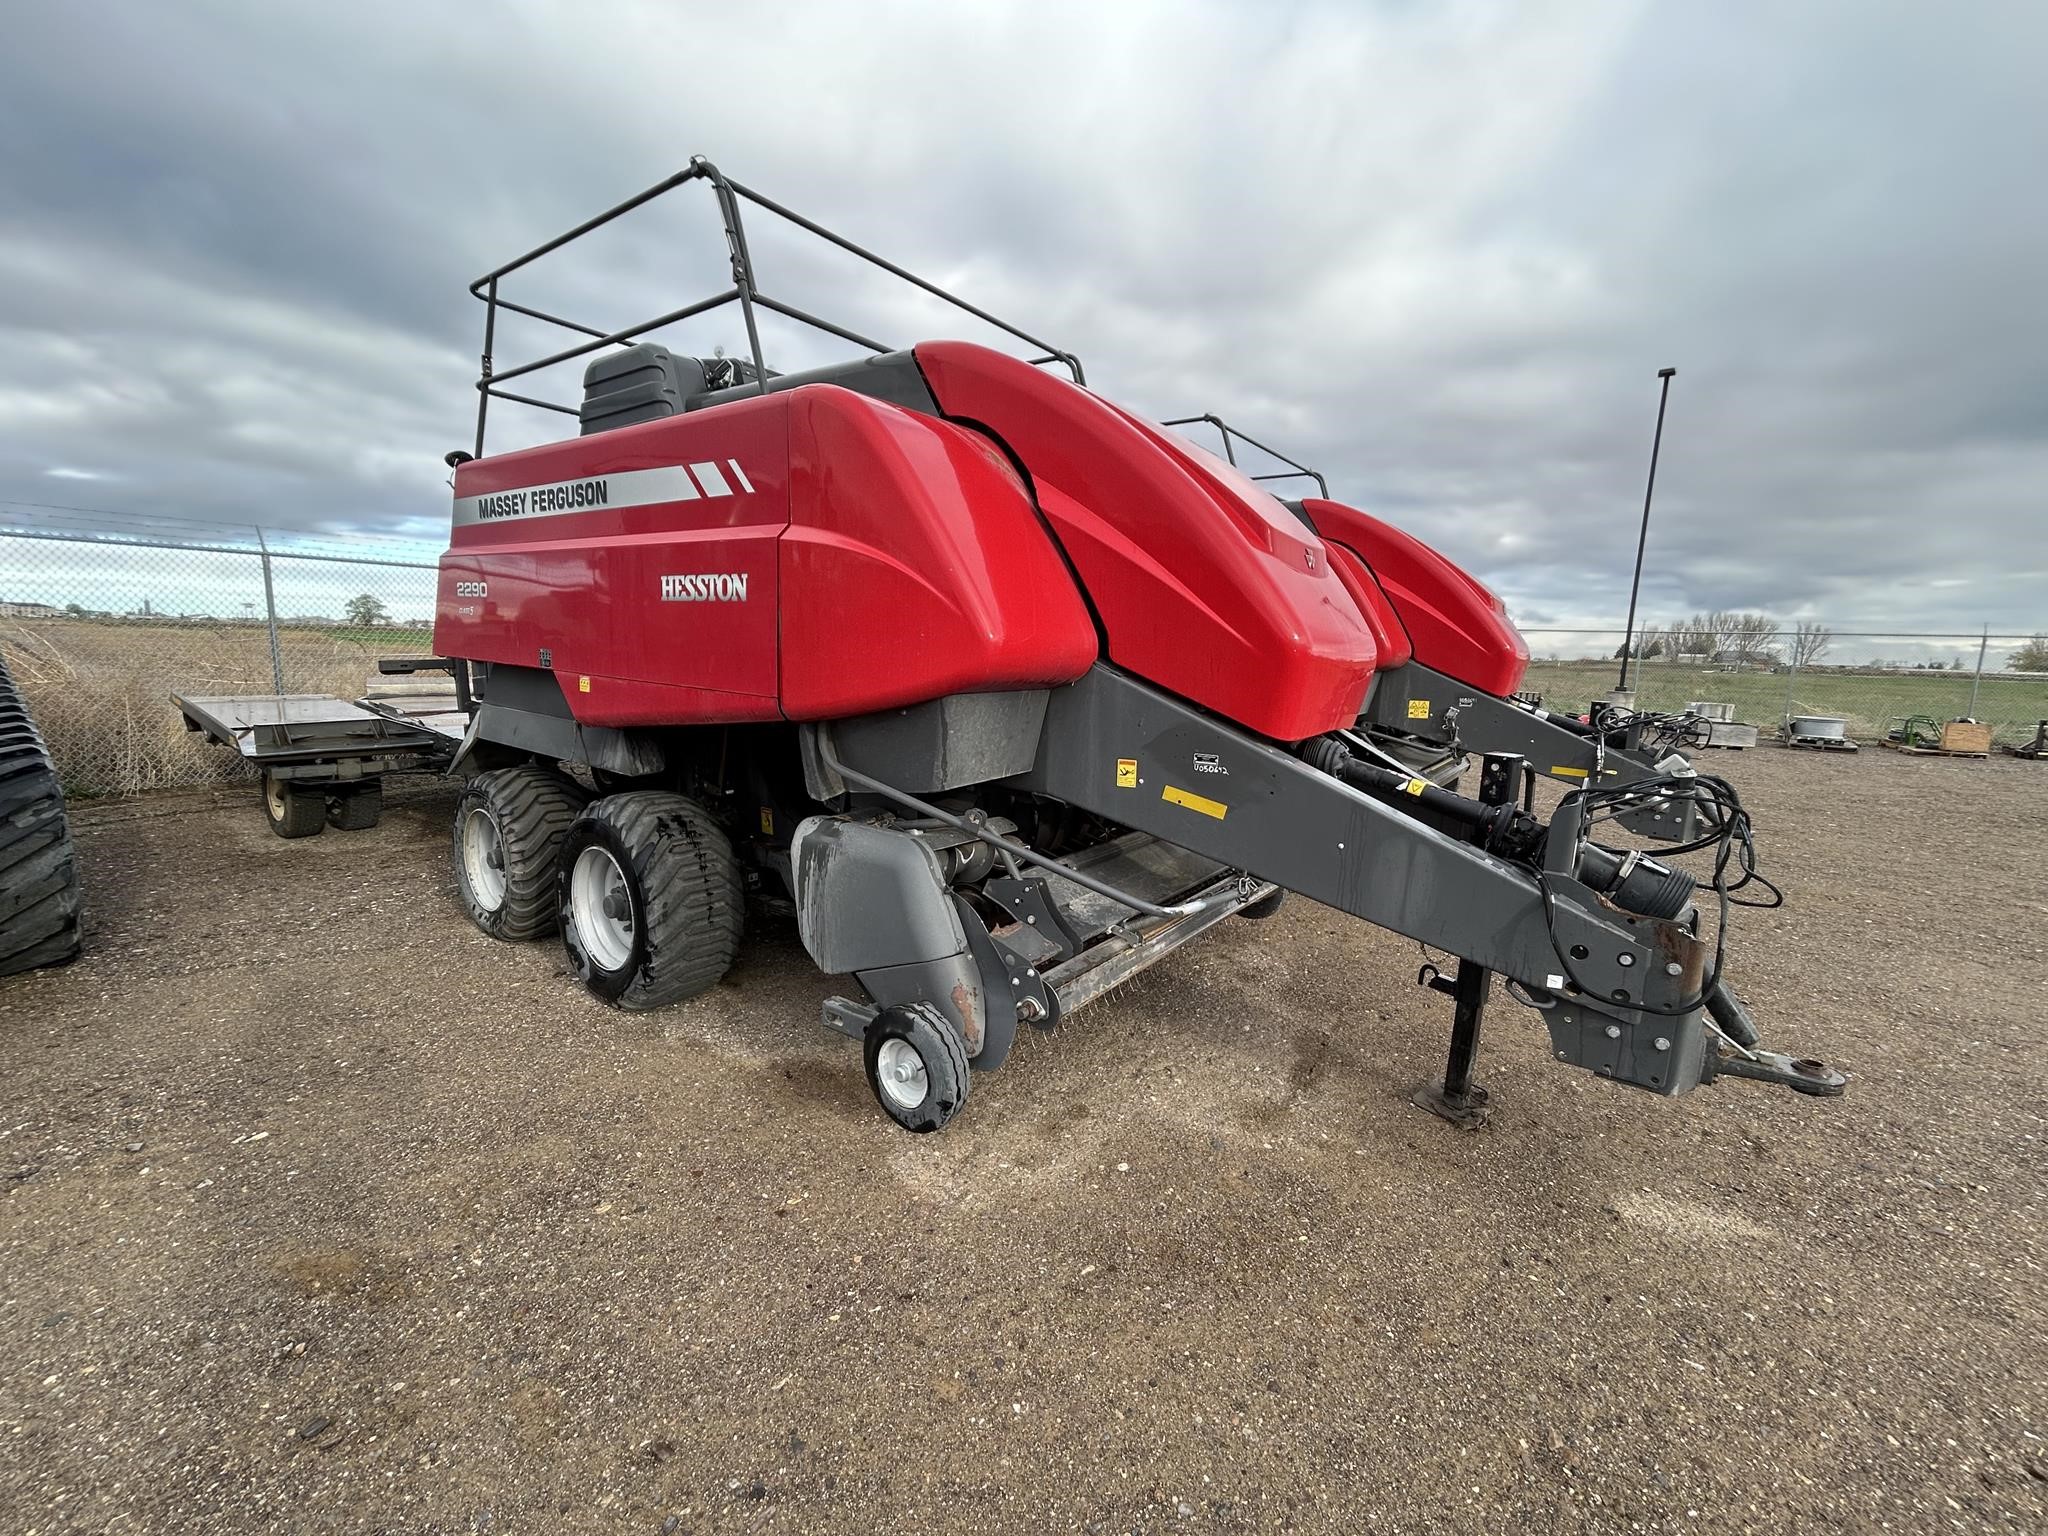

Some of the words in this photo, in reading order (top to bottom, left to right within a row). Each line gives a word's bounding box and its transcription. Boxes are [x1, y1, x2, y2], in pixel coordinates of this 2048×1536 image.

[478, 492, 527, 519] MASSEY
[531, 480, 608, 513] FERGUSON
[456, 582, 488, 598] 2290
[660, 573, 748, 602] HESSTON
